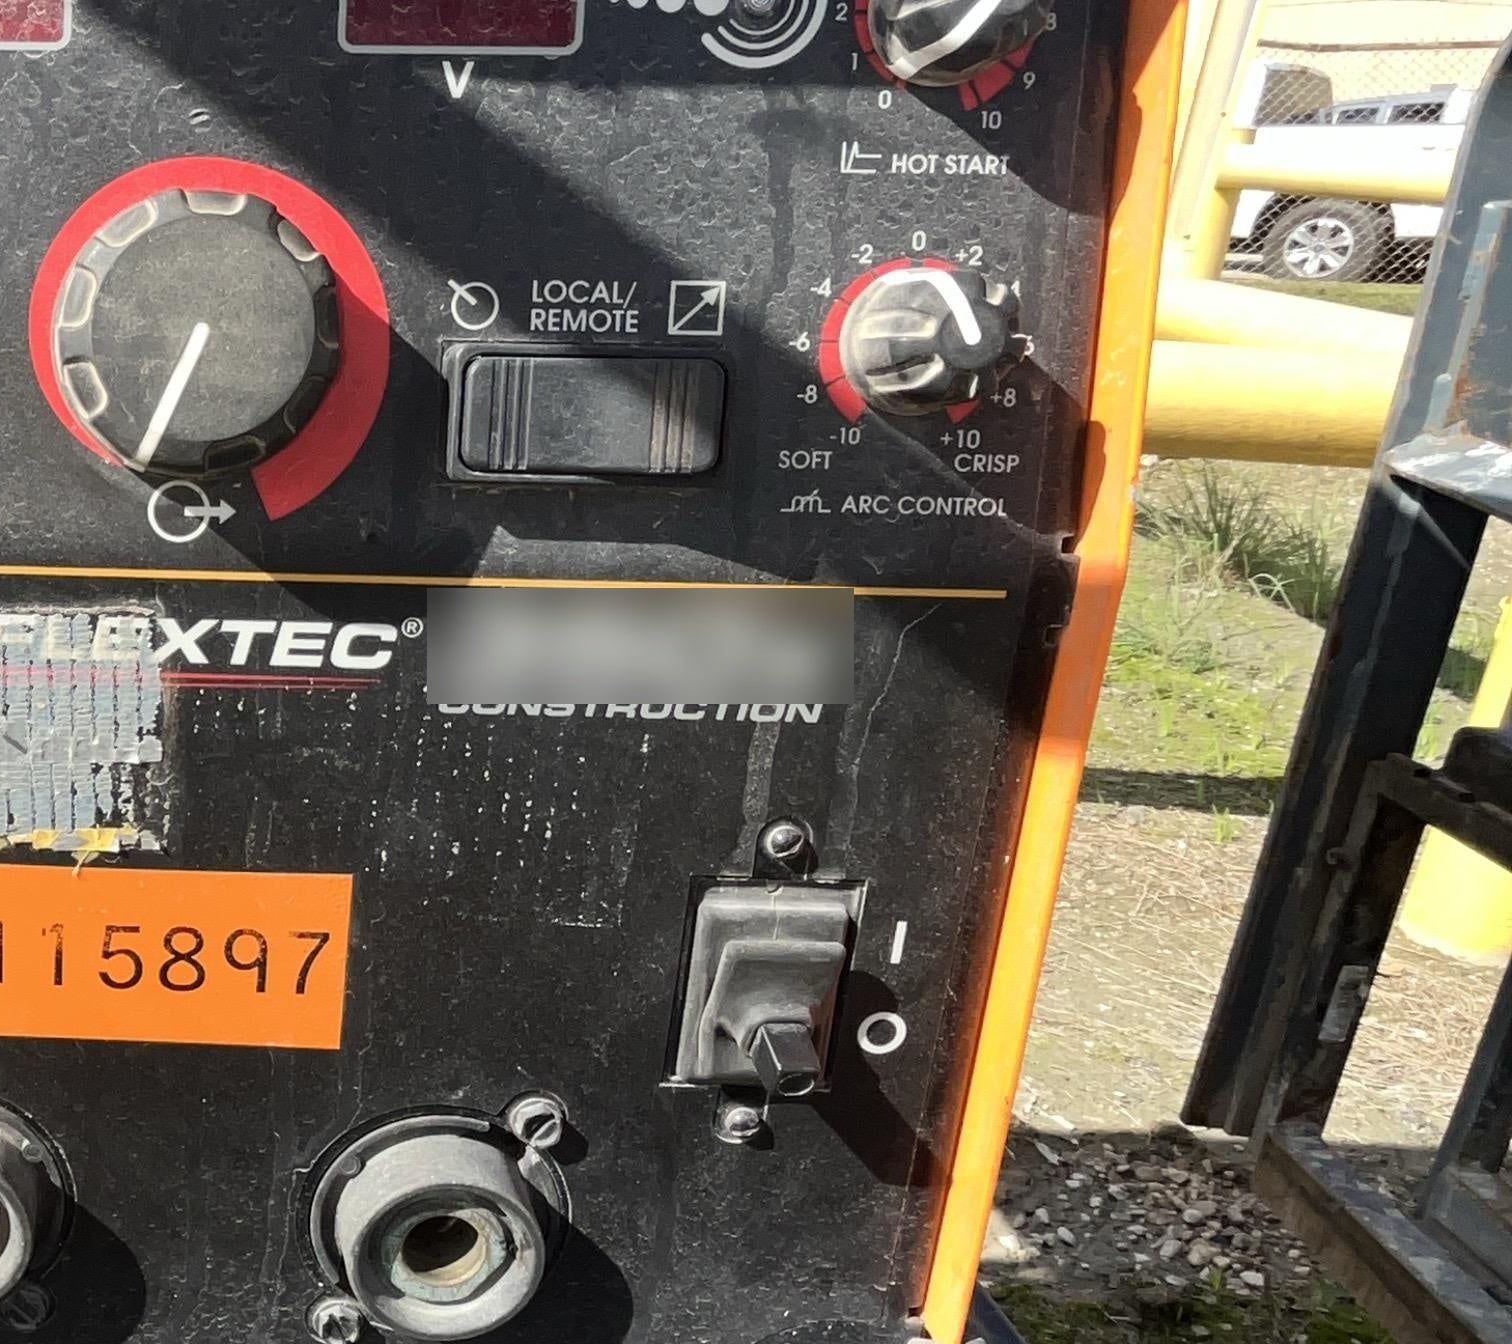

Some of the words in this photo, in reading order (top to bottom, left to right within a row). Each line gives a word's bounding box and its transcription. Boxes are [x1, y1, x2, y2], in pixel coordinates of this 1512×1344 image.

[834, 2, 848, 22] 2
[851, 53, 859, 71] 1
[441, 62, 475, 100] V
[1023, 71, 1036, 90] 9
[877, 90, 892, 110] 0
[981, 111, 1003, 130] 10
[890, 154, 940, 175] HOT
[944, 154, 1009, 177] START
[912, 230, 926, 251] 0
[851, 243, 874, 265] -2
[955, 245, 984, 267] +2
[531, 279, 637, 308] LOCAL/
[810, 277, 832, 298] -4
[530, 308, 639, 333] REMOTE
[788, 331, 811, 353] -6
[796, 385, 818, 405] -8
[990, 387, 1017, 407] +8
[829, 427, 862, 445] -10
[940, 429, 981, 450] +10
[778, 450, 833, 470] SOFT
[954, 453, 1020, 473] CRISP
[841, 495, 891, 514] ARC
[897, 496, 1008, 517] CONTROL
